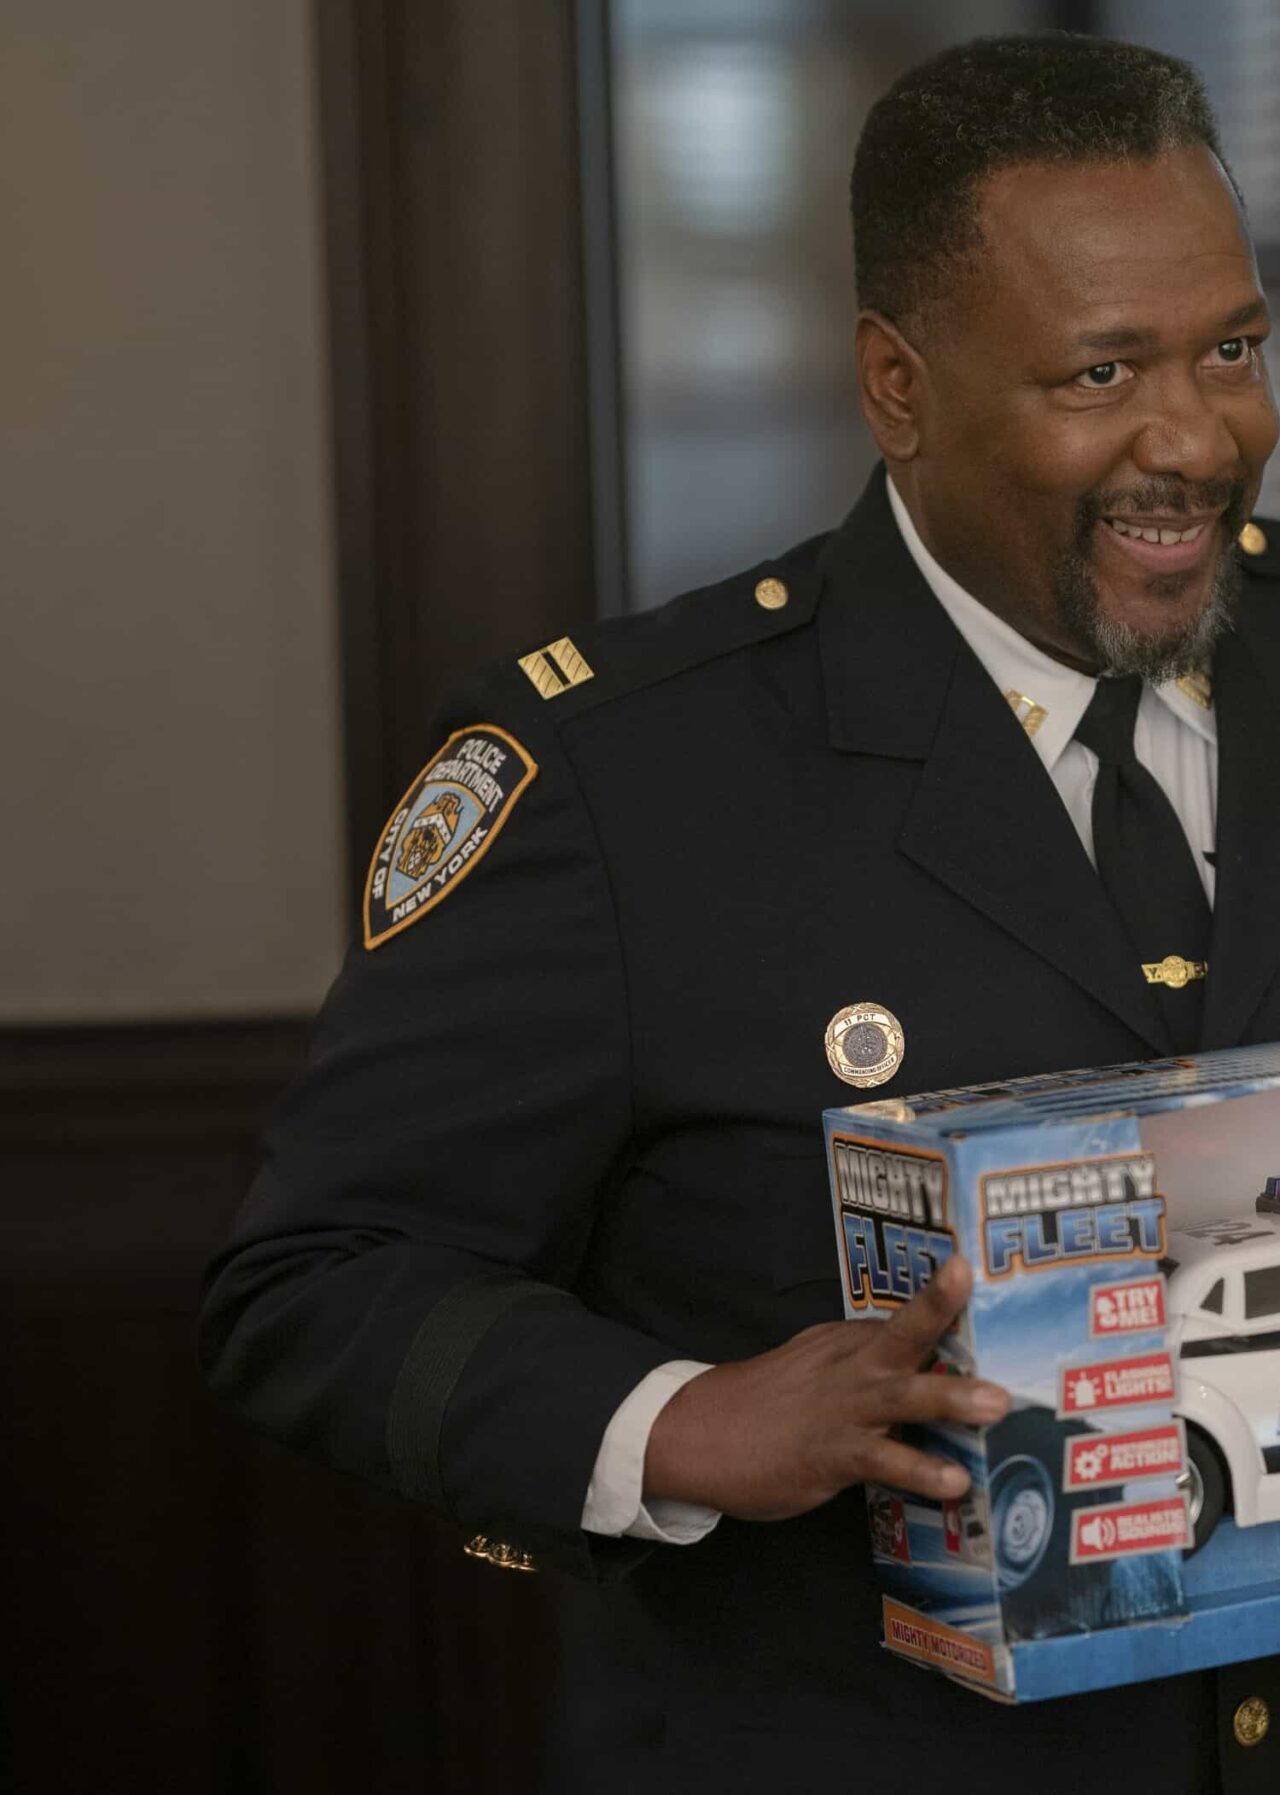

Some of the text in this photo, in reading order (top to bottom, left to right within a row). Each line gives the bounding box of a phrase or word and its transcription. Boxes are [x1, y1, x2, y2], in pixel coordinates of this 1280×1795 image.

[456, 738, 507, 775] POLICE
[424, 759, 504, 813] DEPARTMENT
[372, 807, 409, 899] CITY OF
[392, 826, 488, 923] NEW YORK
[834, 1142, 944, 1228] MIGHTY
[986, 1158, 1154, 1215] MIGHTY
[986, 1200, 1164, 1274] FLEET
[1112, 1285, 1160, 1312] TRY
[891, 1619, 987, 1671] MIGHTY MOTORIZED
